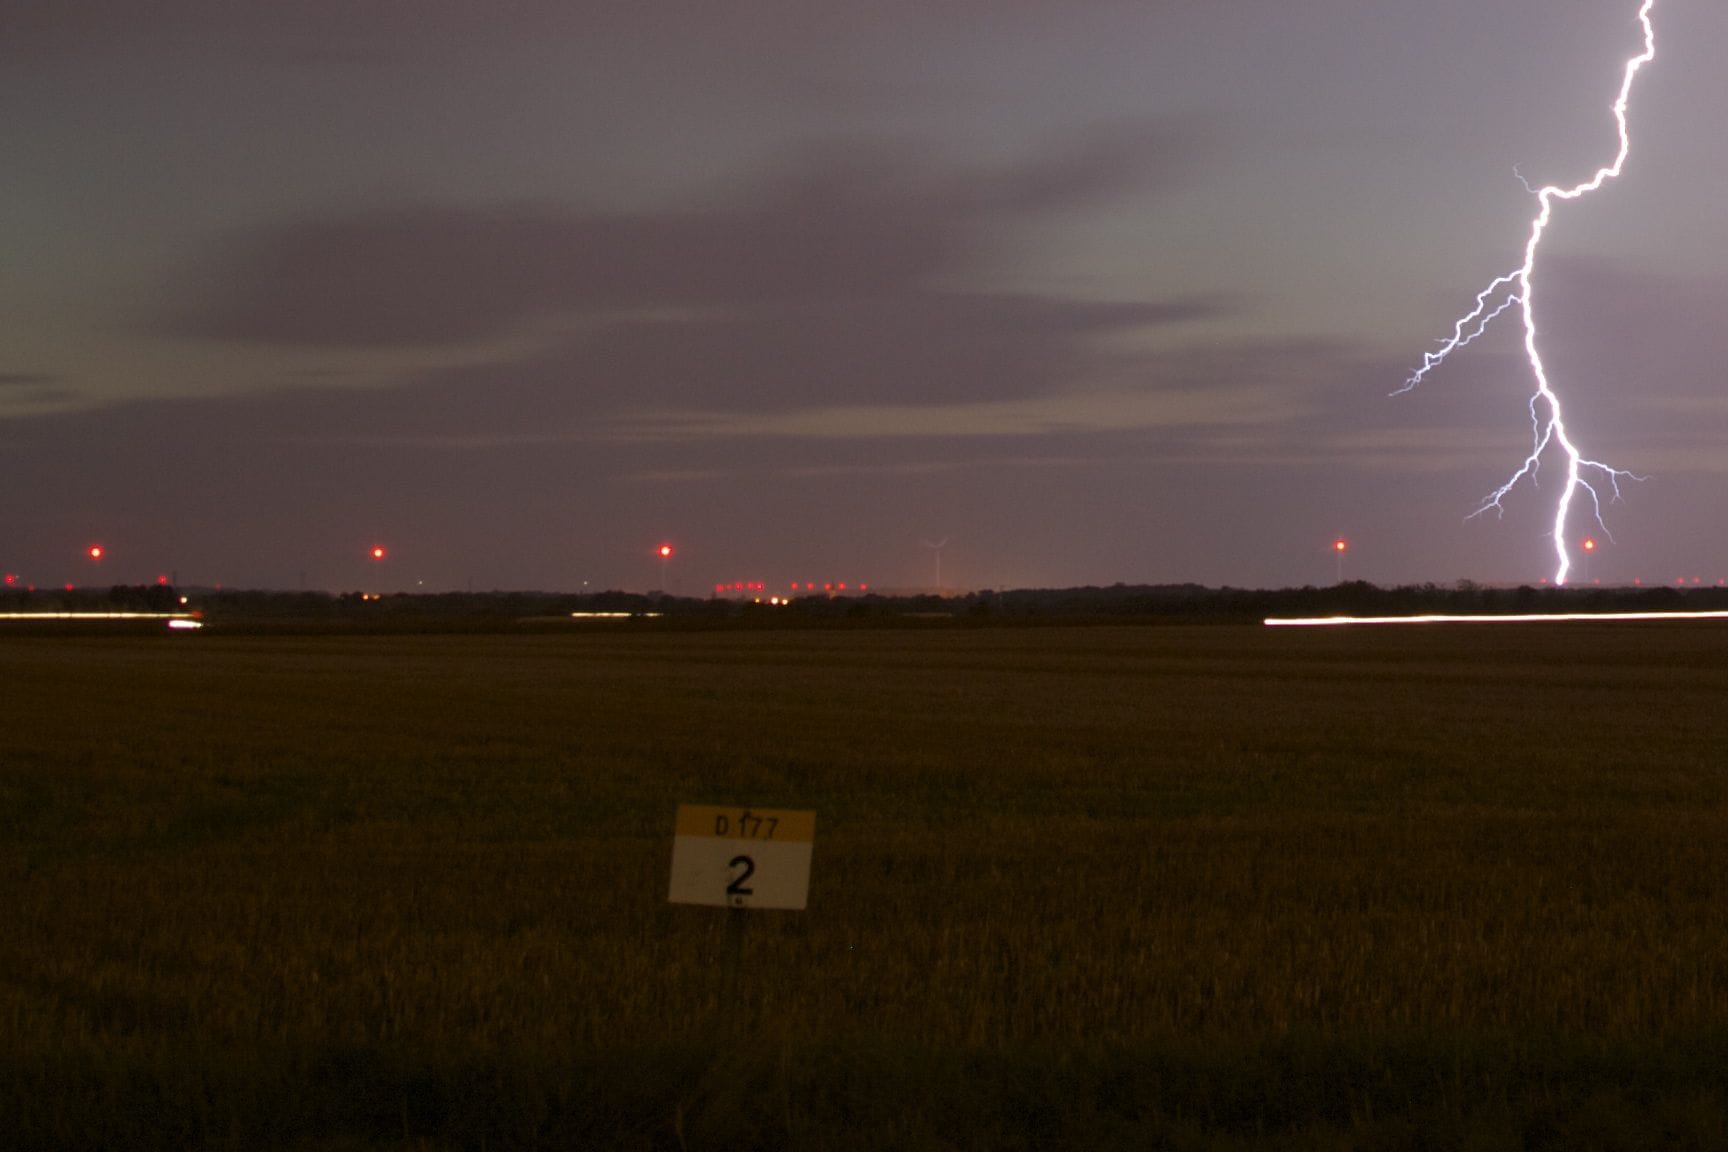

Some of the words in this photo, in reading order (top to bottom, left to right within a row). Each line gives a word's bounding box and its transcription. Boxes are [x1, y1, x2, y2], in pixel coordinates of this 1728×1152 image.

[715, 814, 729, 836] D
[738, 814, 780, 838] 177
[726, 853, 755, 896] 2
